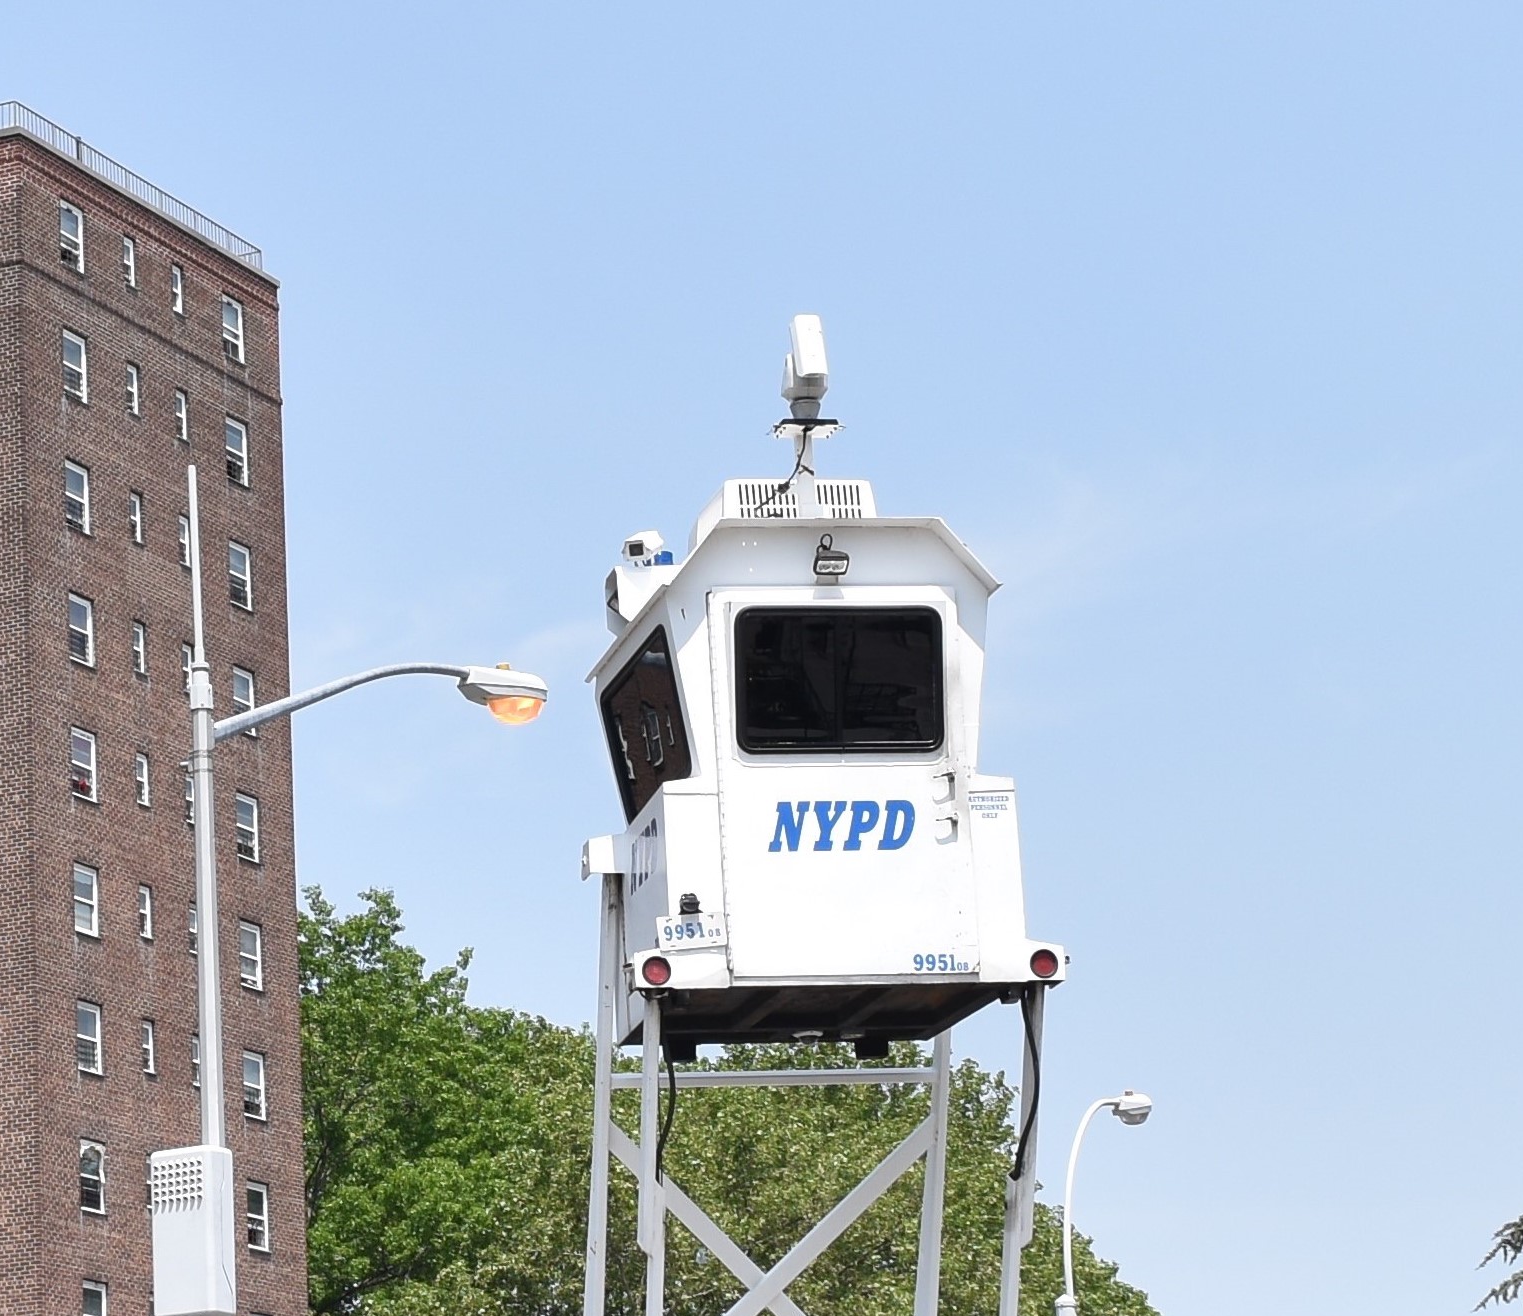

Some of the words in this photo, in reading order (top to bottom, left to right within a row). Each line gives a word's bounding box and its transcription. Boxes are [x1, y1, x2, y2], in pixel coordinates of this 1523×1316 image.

[768, 800, 916, 852] NYPD
[663, 922, 706, 941] 9951
[913, 953, 956, 972] 9951
[957, 961, 969, 972] 08
